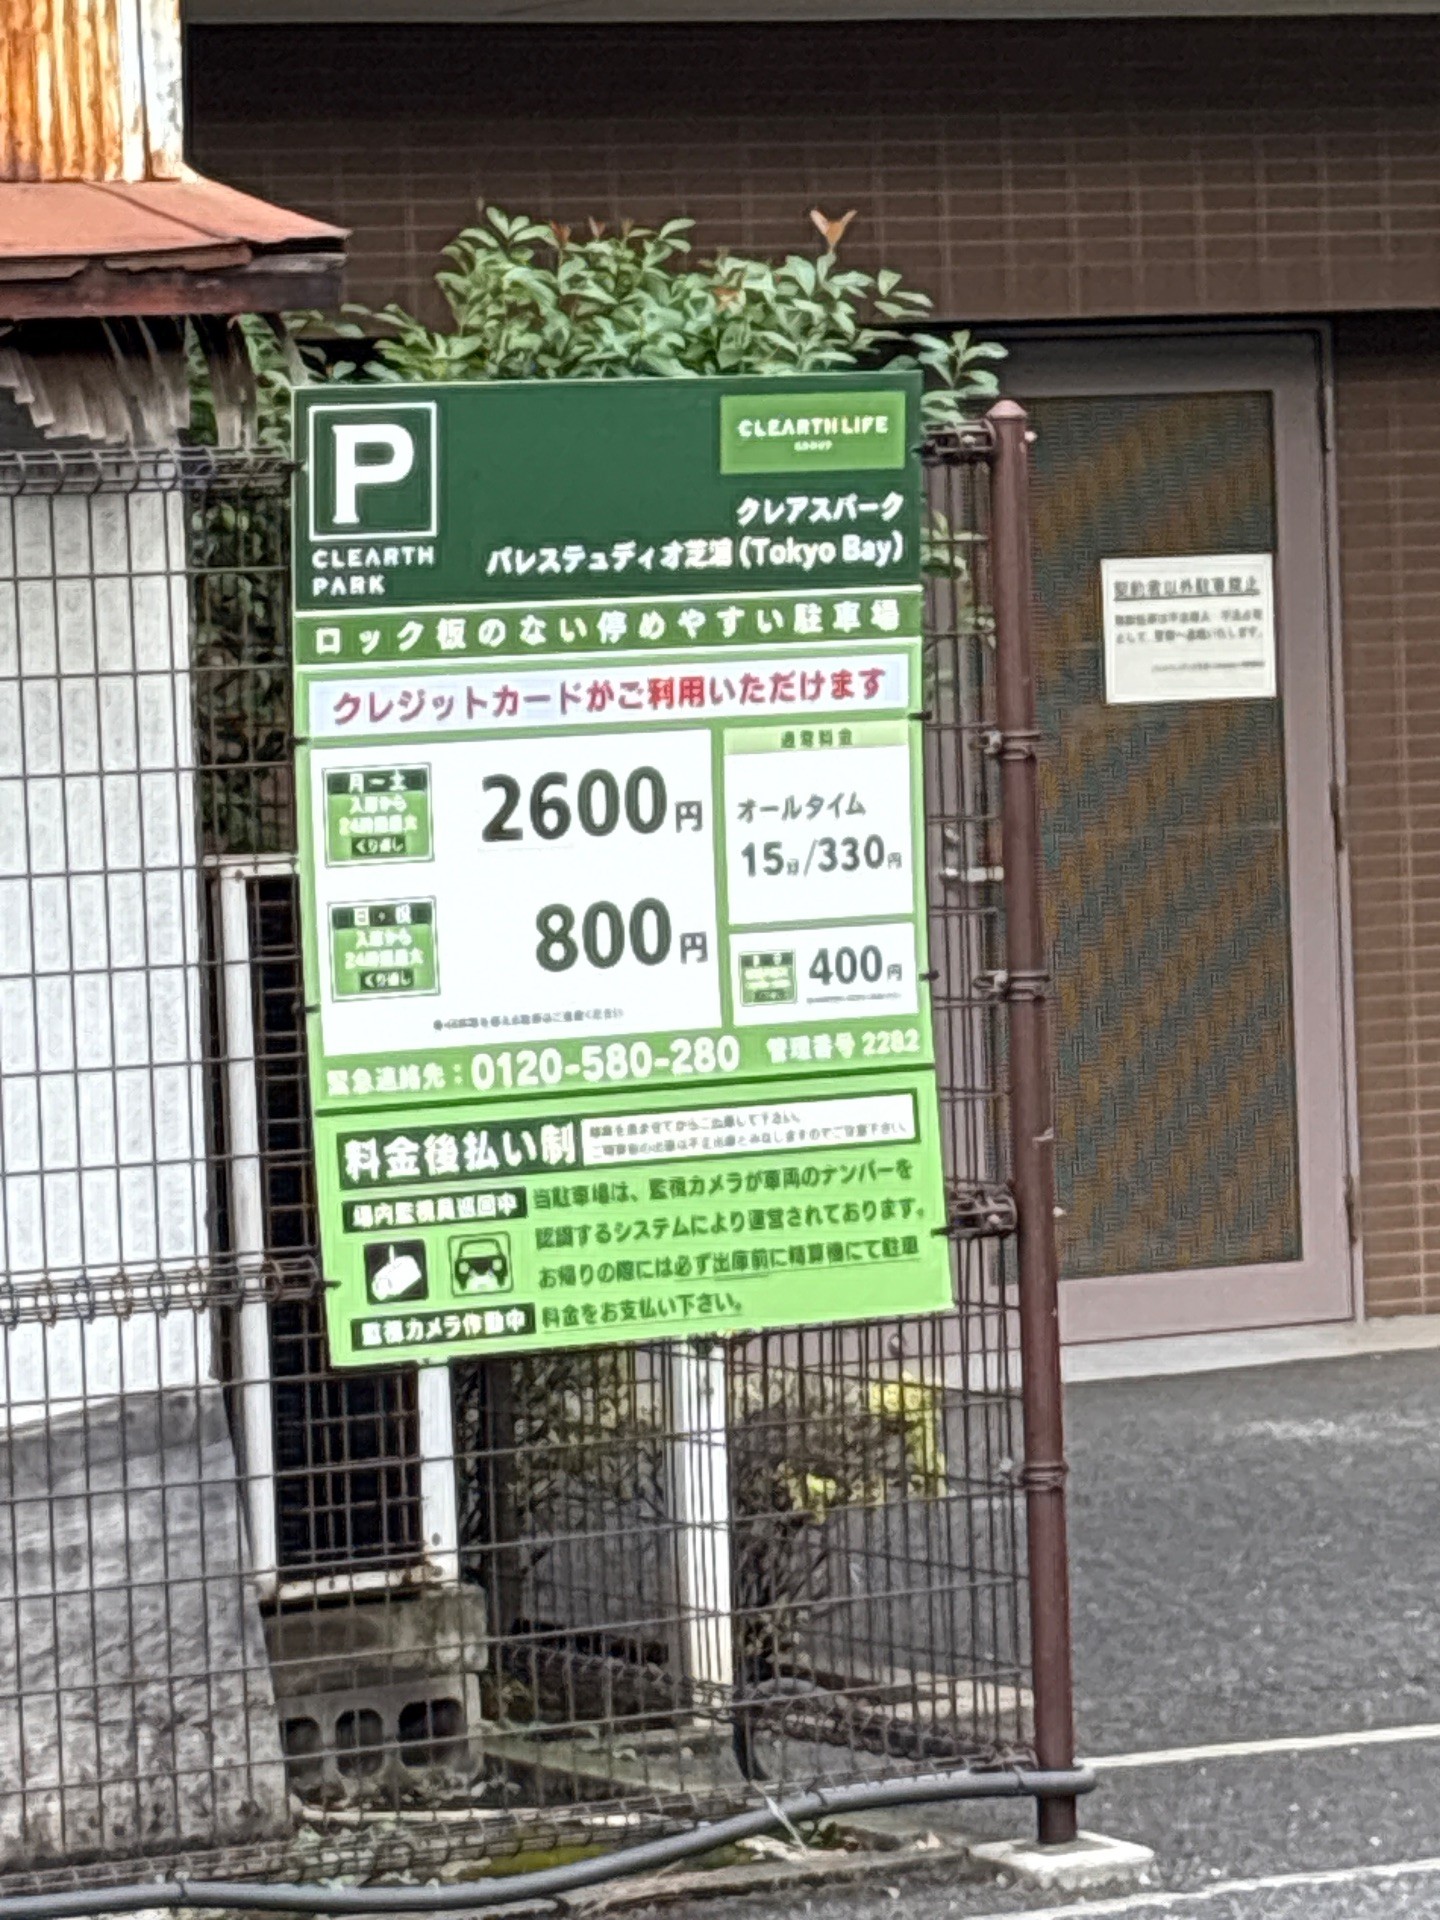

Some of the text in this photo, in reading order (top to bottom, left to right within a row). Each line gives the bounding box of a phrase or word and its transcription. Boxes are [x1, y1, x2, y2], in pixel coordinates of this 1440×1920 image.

[331, 424, 414, 523] P
[736, 491, 904, 526] クレアスパーク
[311, 545, 435, 569] CLEARTH
[738, 535, 837, 572] (Tokyo
[842, 529, 904, 568] Bay)
[312, 574, 386, 597] PARK
[316, 599, 899, 655] ロック板のない停めやすい駐車場
[333, 668, 886, 725] クレジットカードがご利用いただけます
[482, 765, 703, 842] 2600円
[737, 791, 866, 824] オールタイム
[535, 897, 708, 973] 800円
[471, 1035, 740, 1090] 0120-580-280
[344, 1121, 576, 1183] 料金後払い制
